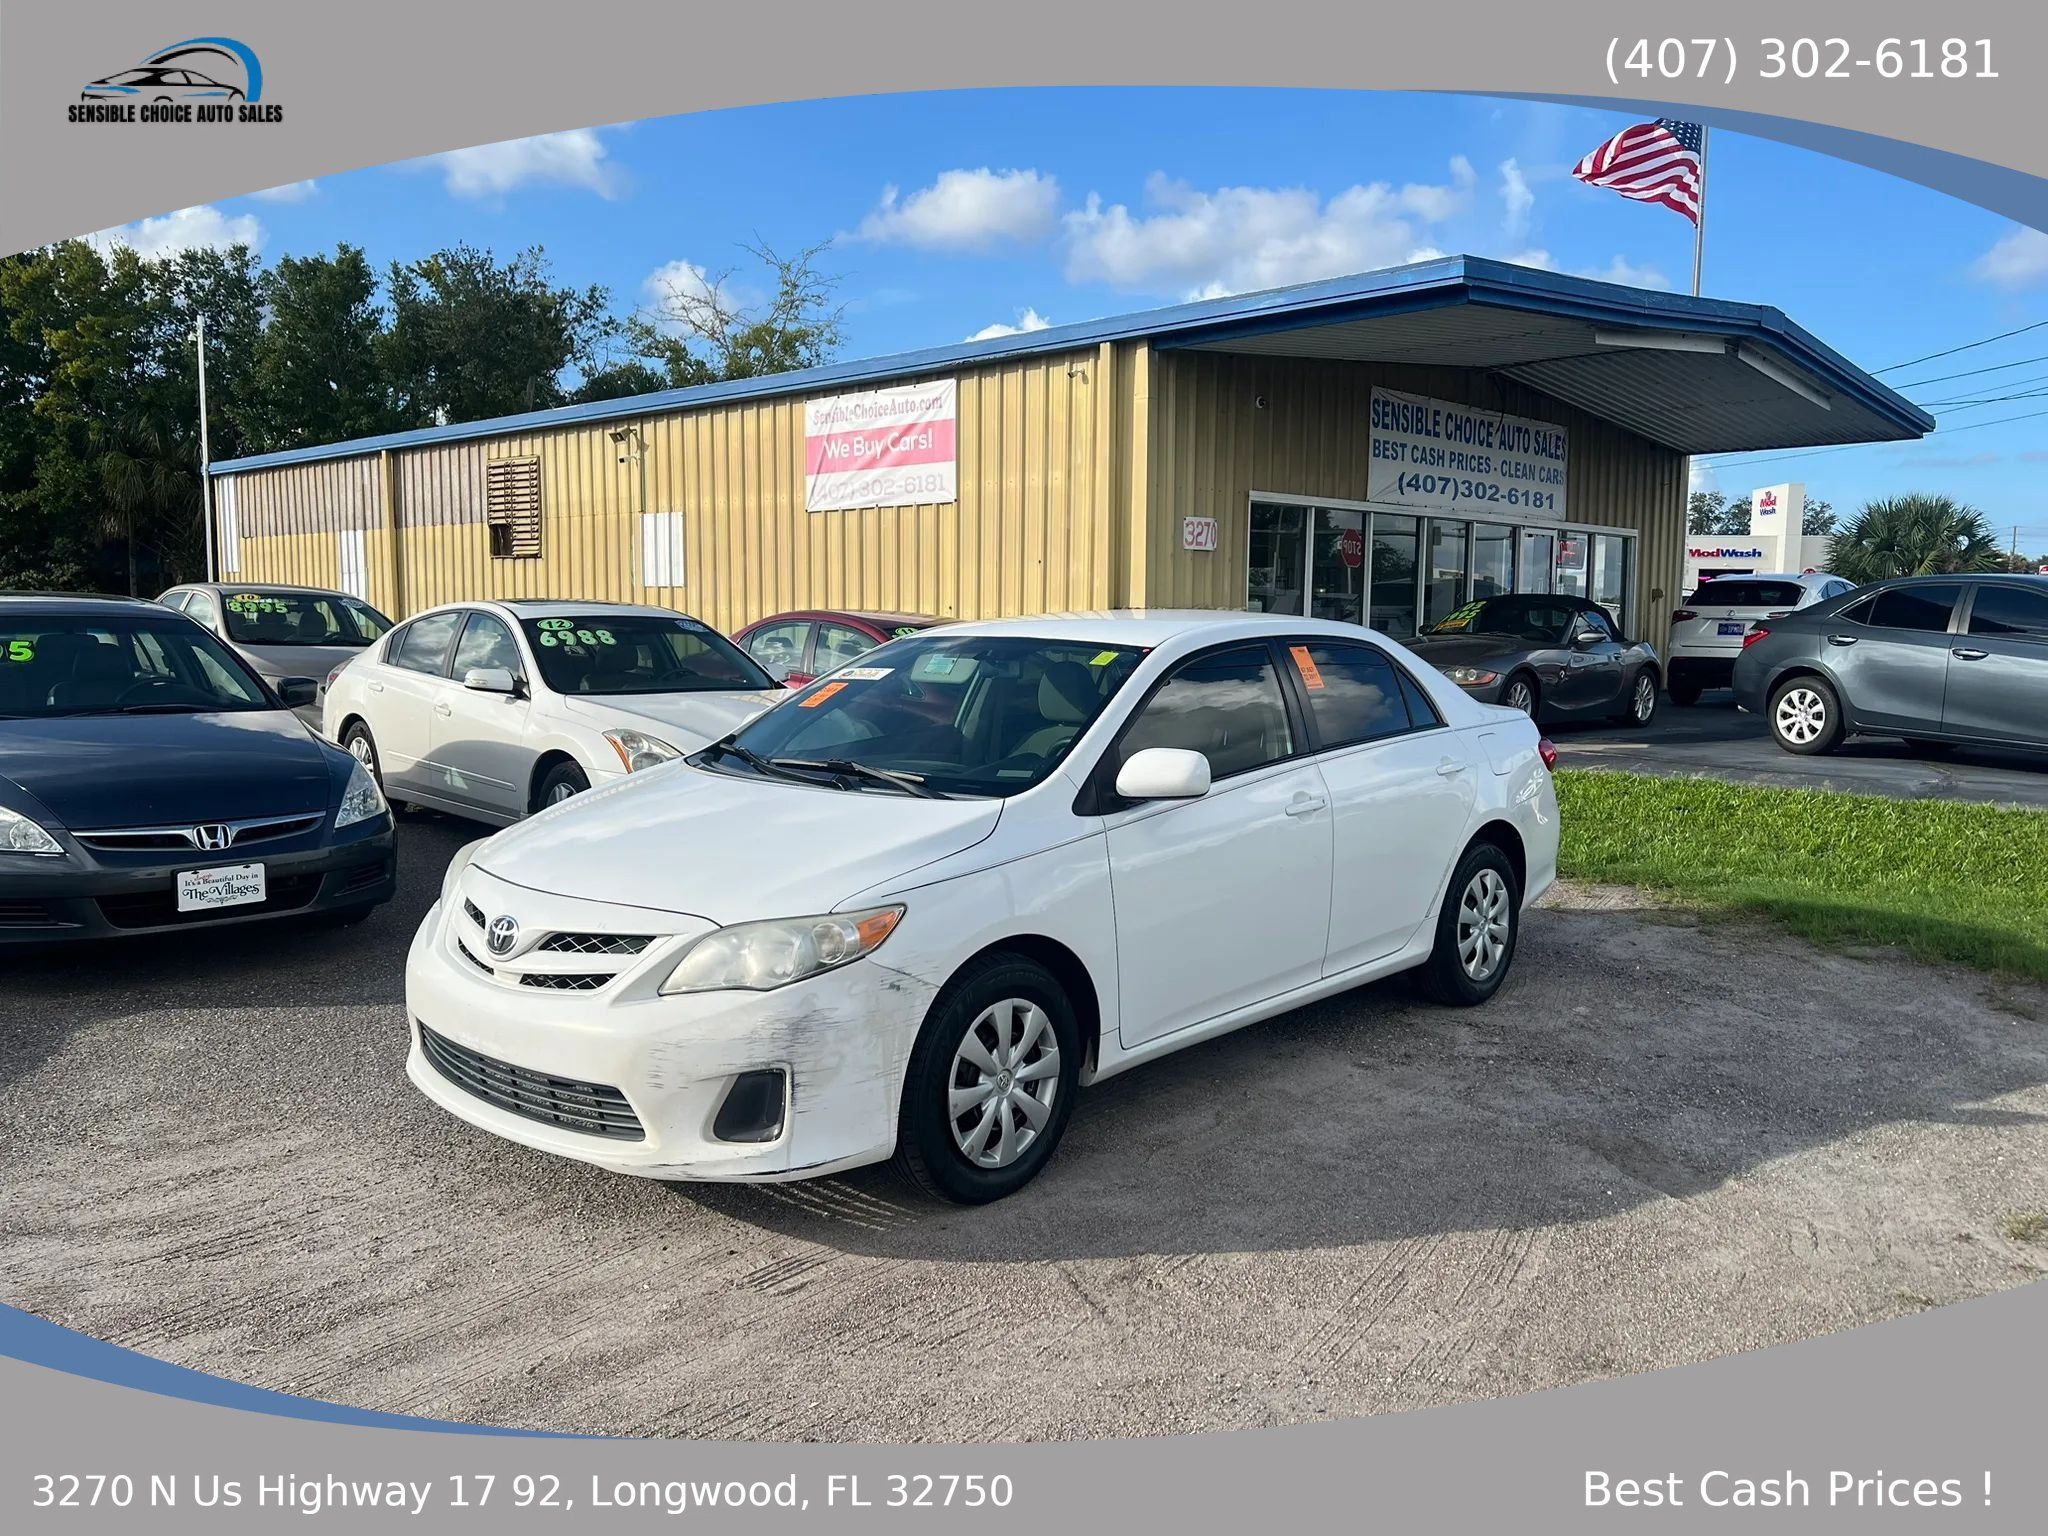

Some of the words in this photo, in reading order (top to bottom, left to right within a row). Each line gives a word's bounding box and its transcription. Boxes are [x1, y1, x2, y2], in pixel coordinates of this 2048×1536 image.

[1372, 398, 1441, 438] SENSIBLE
[1445, 412, 1493, 449] CHOICE
[1499, 423, 1531, 454] AUTO
[1533, 431, 1567, 462] SALES
[825, 440, 850, 460] We
[853, 436, 885, 460] Buy
[887, 427, 933, 451] Cars!
[1372, 438, 1407, 461] BEST
[1411, 444, 1445, 467] CASH
[1449, 454, 1491, 475] PRICES
[1501, 459, 1536, 481] CLEAN
[1539, 467, 1564, 486] CARS
[1398, 471, 1554, 510] (407)302-6181
[1760, 496, 1777, 507] Mod
[1760, 507, 1776, 517] Wash
[1185, 521, 1217, 547] 3270
[229, 601, 288, 613] 8995
[540, 630, 617, 647] 6988
[203, 874, 234, 885] Beautiful
[236, 873, 250, 882] Day
[182, 888, 209, 901] The
[209, 882, 260, 897] Villages
